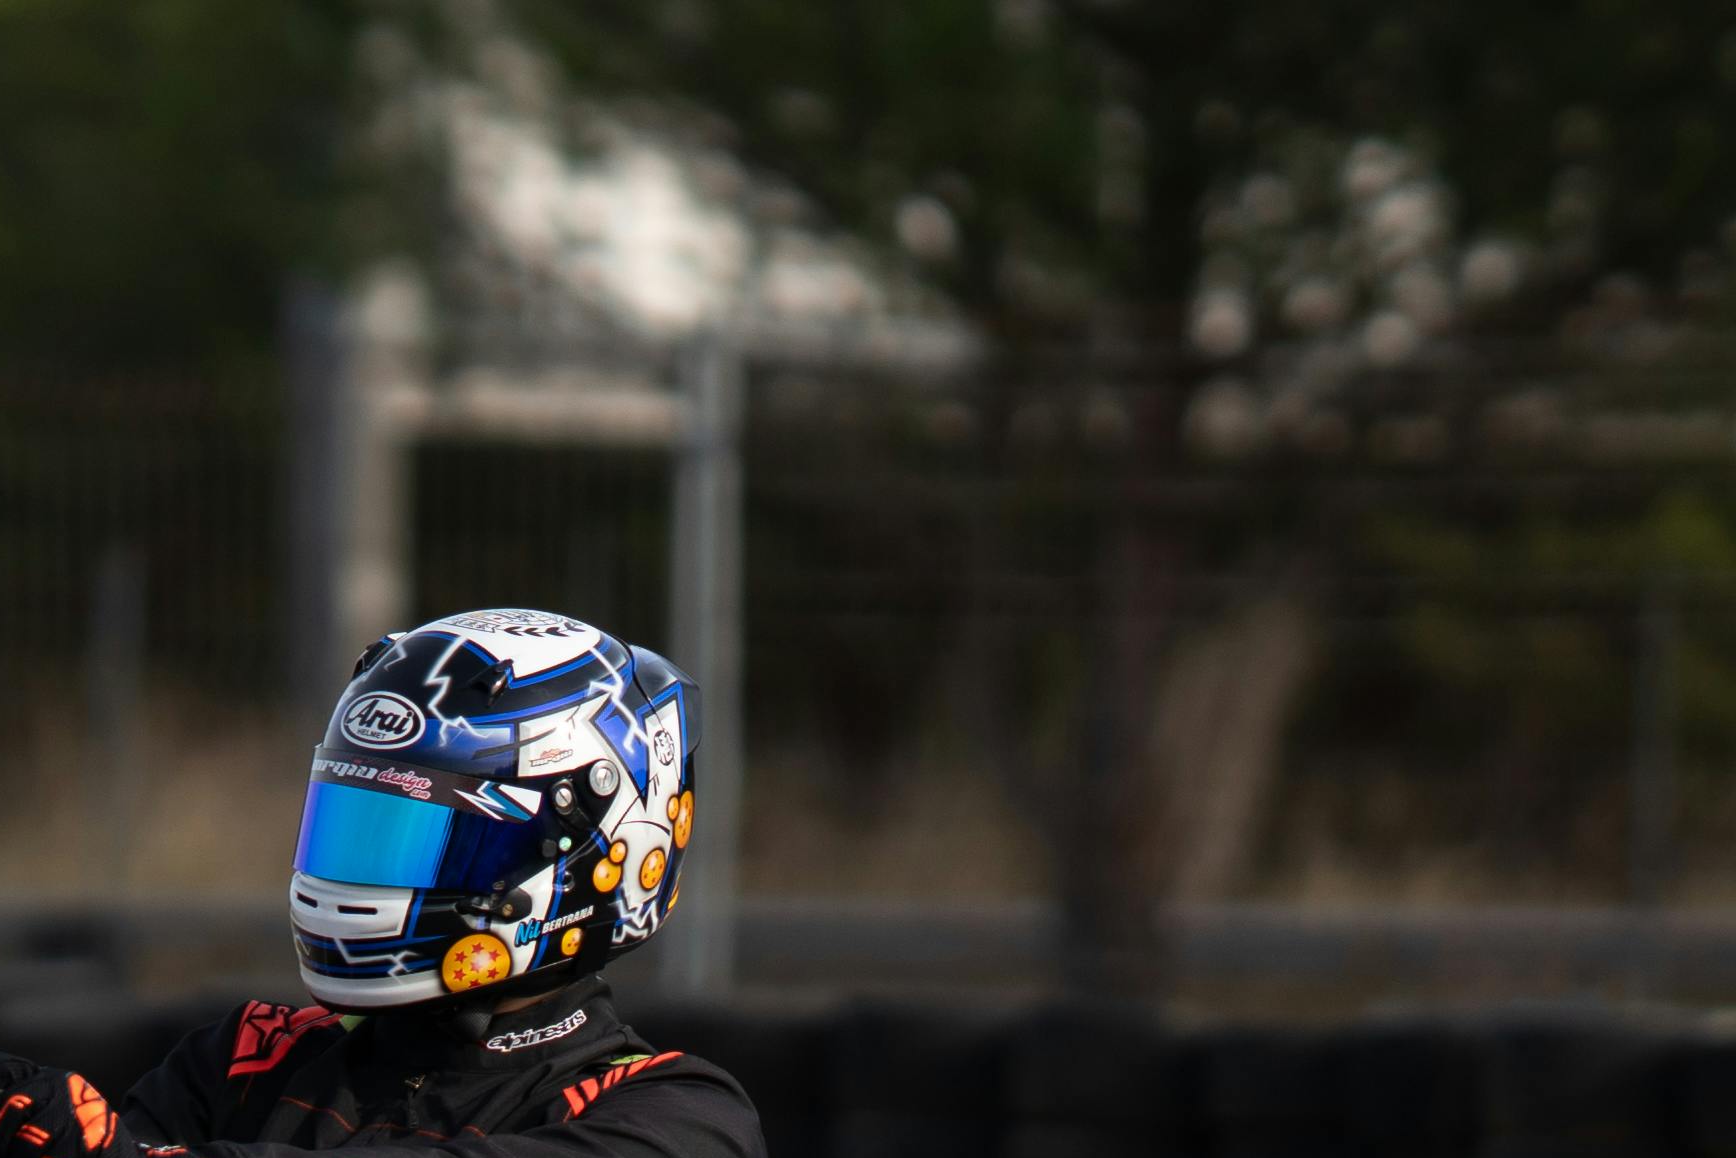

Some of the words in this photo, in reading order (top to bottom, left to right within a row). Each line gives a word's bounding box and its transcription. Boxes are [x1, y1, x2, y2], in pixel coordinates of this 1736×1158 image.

[345, 698, 414, 735] Arai
[356, 728, 387, 740] HELMET
[377, 767, 432, 791] design
[514, 918, 542, 947] Nil
[542, 905, 594, 934] BERTRANA
[486, 1009, 587, 1053] alpinestrs
